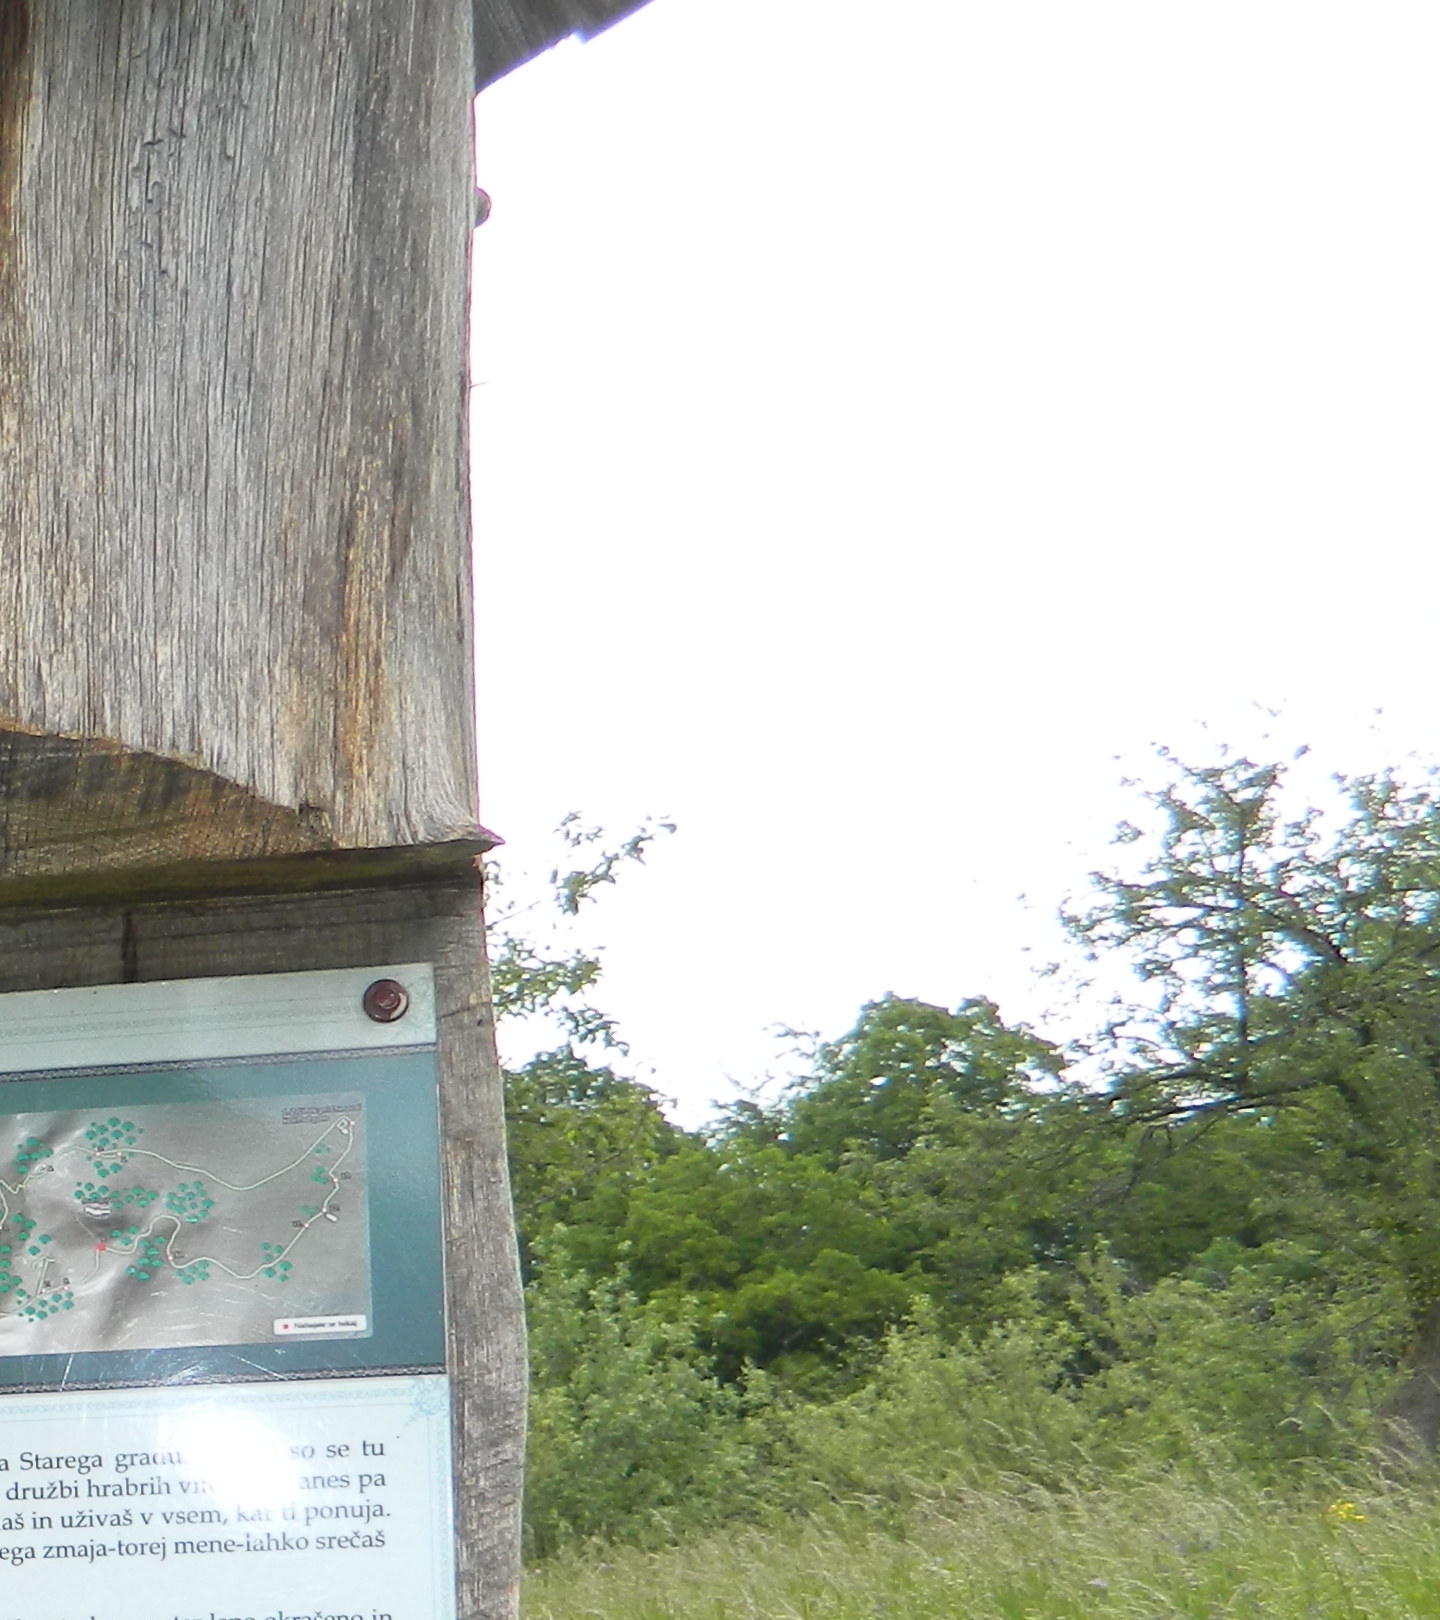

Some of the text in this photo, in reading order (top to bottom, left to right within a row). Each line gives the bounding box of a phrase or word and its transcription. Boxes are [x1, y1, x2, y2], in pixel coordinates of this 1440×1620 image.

[19, 1451, 103, 1475] Starega
[5, 1479, 80, 1501] družbi
[86, 1475, 171, 1498] hrabrih
[60, 1508, 133, 1529] uživaš
[305, 1498, 391, 1527] ponuja.
[42, 1536, 167, 1564] zmaja-torej
[315, 1529, 386, 1550] srečaš
